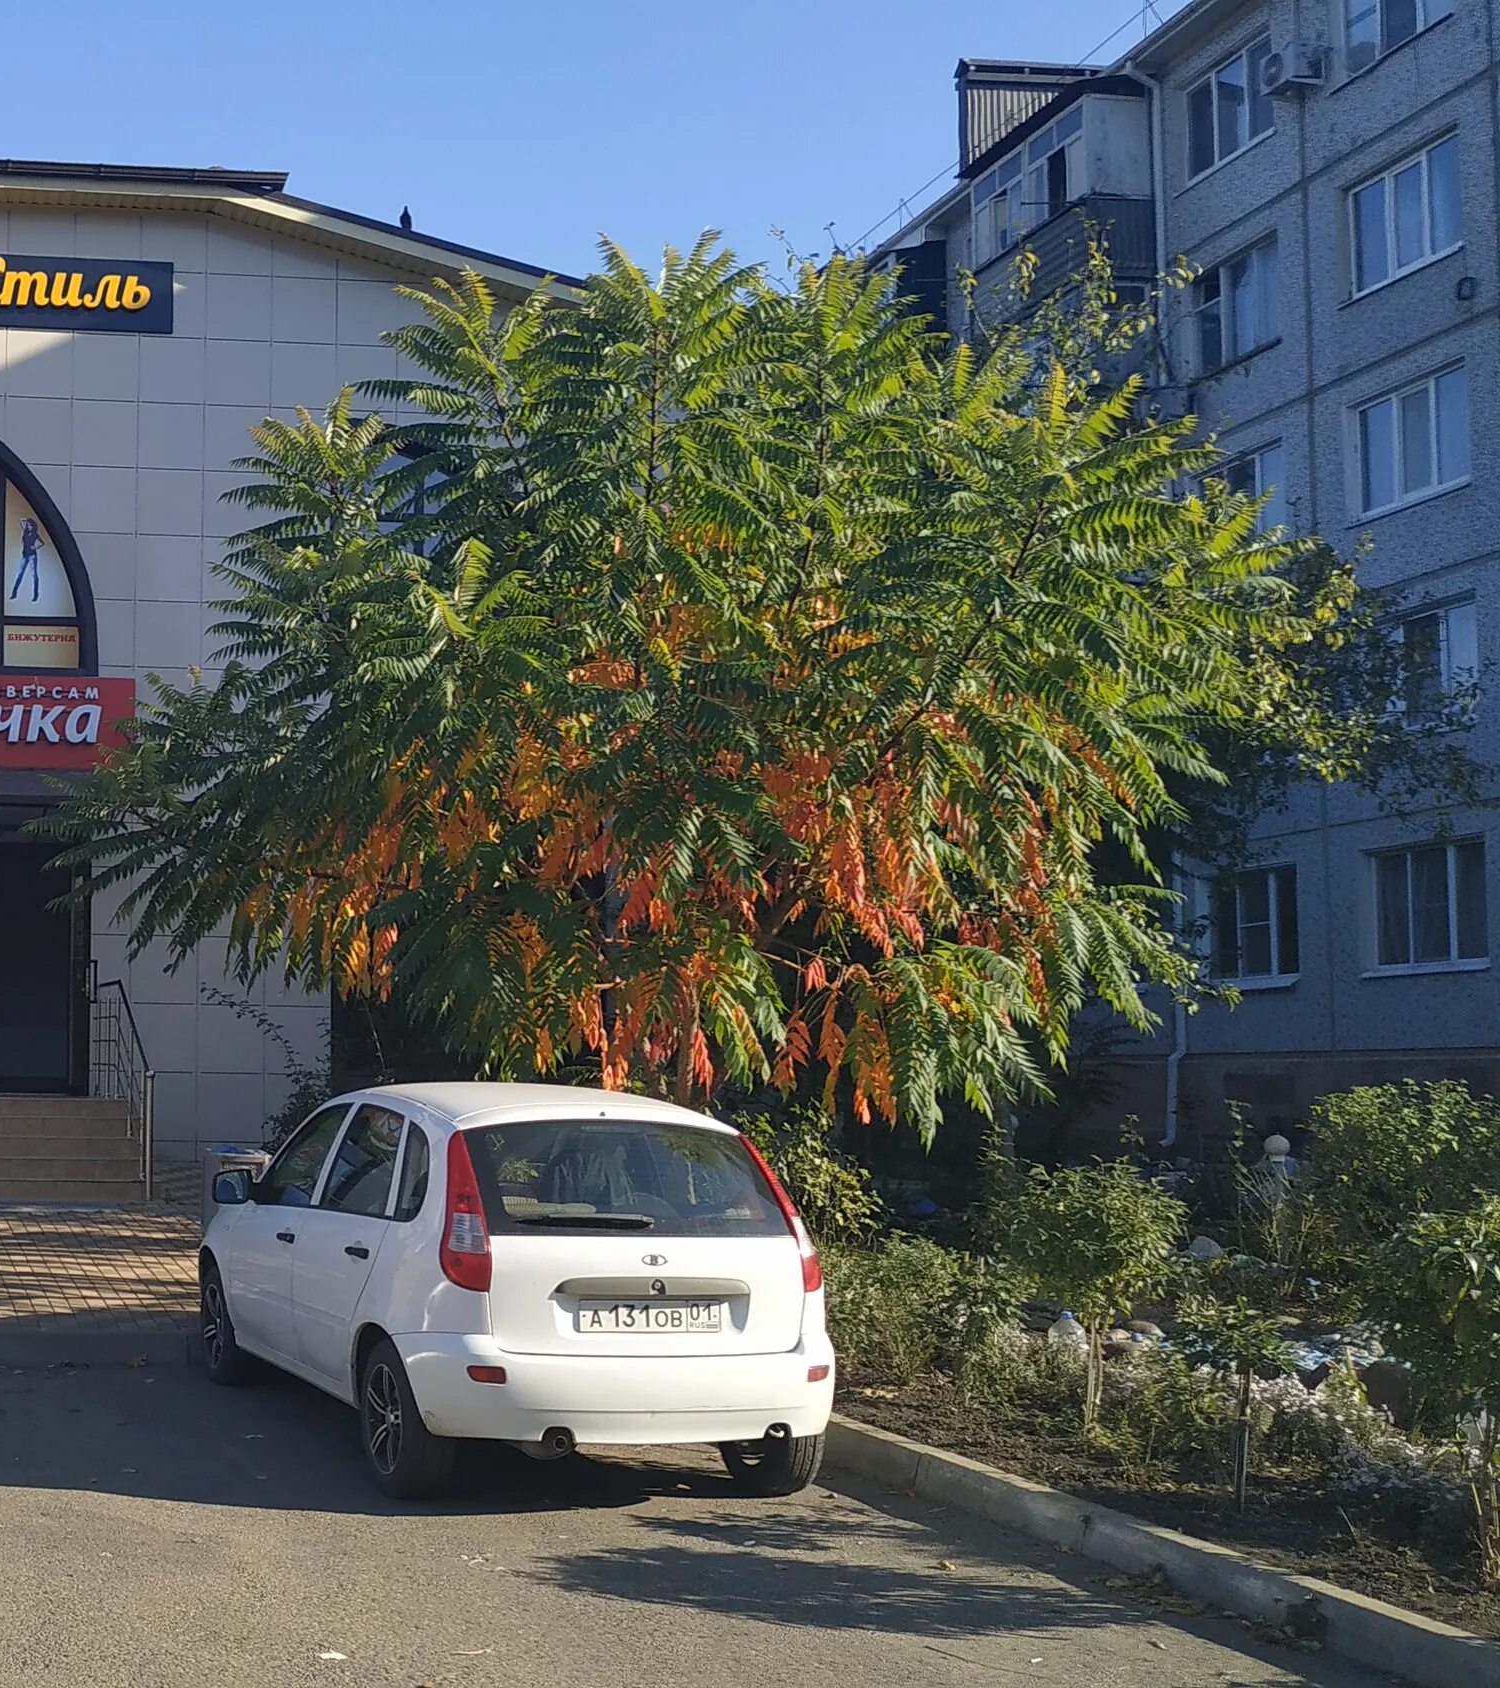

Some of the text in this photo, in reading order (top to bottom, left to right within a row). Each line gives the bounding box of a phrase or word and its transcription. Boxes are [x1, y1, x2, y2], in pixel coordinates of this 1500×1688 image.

[7, 633, 76, 643] БИЖУТЕРИЯ
[590, 1303, 713, 1328] А131ОВ 01
[689, 1321, 706, 1329] RUS
